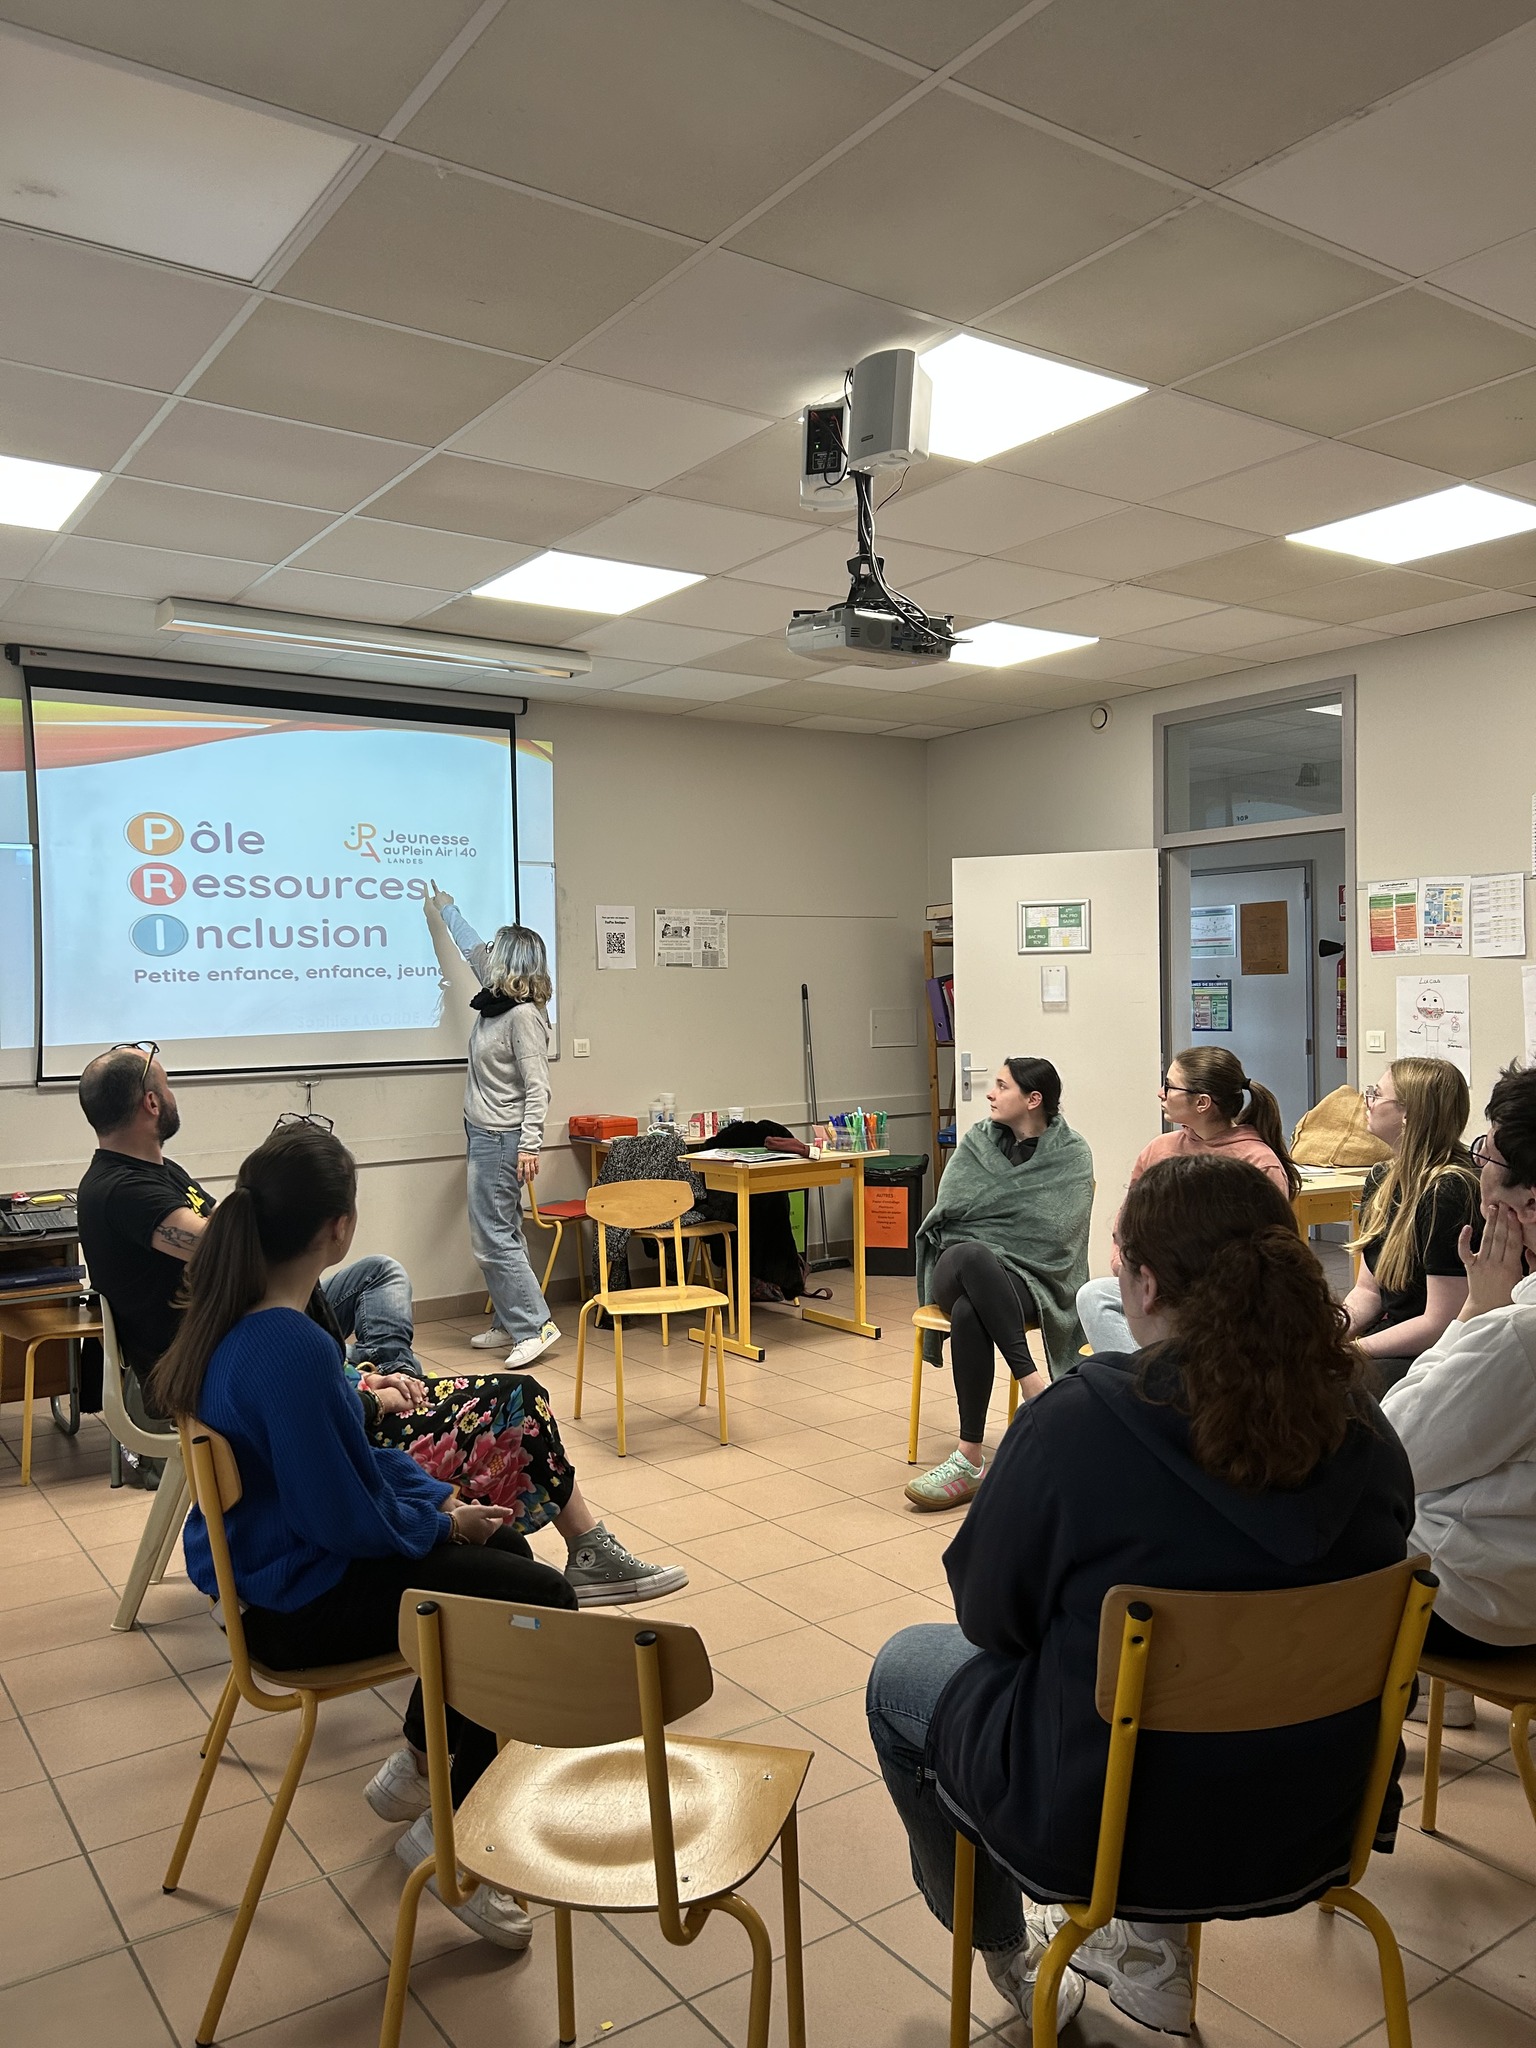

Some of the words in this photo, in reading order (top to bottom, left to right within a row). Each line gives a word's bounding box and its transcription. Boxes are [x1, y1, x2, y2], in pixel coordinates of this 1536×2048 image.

[143, 817, 265, 855] Pôle
[383, 829, 470, 846] Jeunesse
[387, 857, 424, 865] LANDES
[435, 846, 453, 857] Air
[459, 847, 477, 858] 40
[142, 867, 427, 900] Ressources
[155, 917, 388, 951] Inclusion
[134, 968, 200, 984] Petite
[207, 966, 299, 982] enfance,
[305, 964, 392, 981] enfance,
